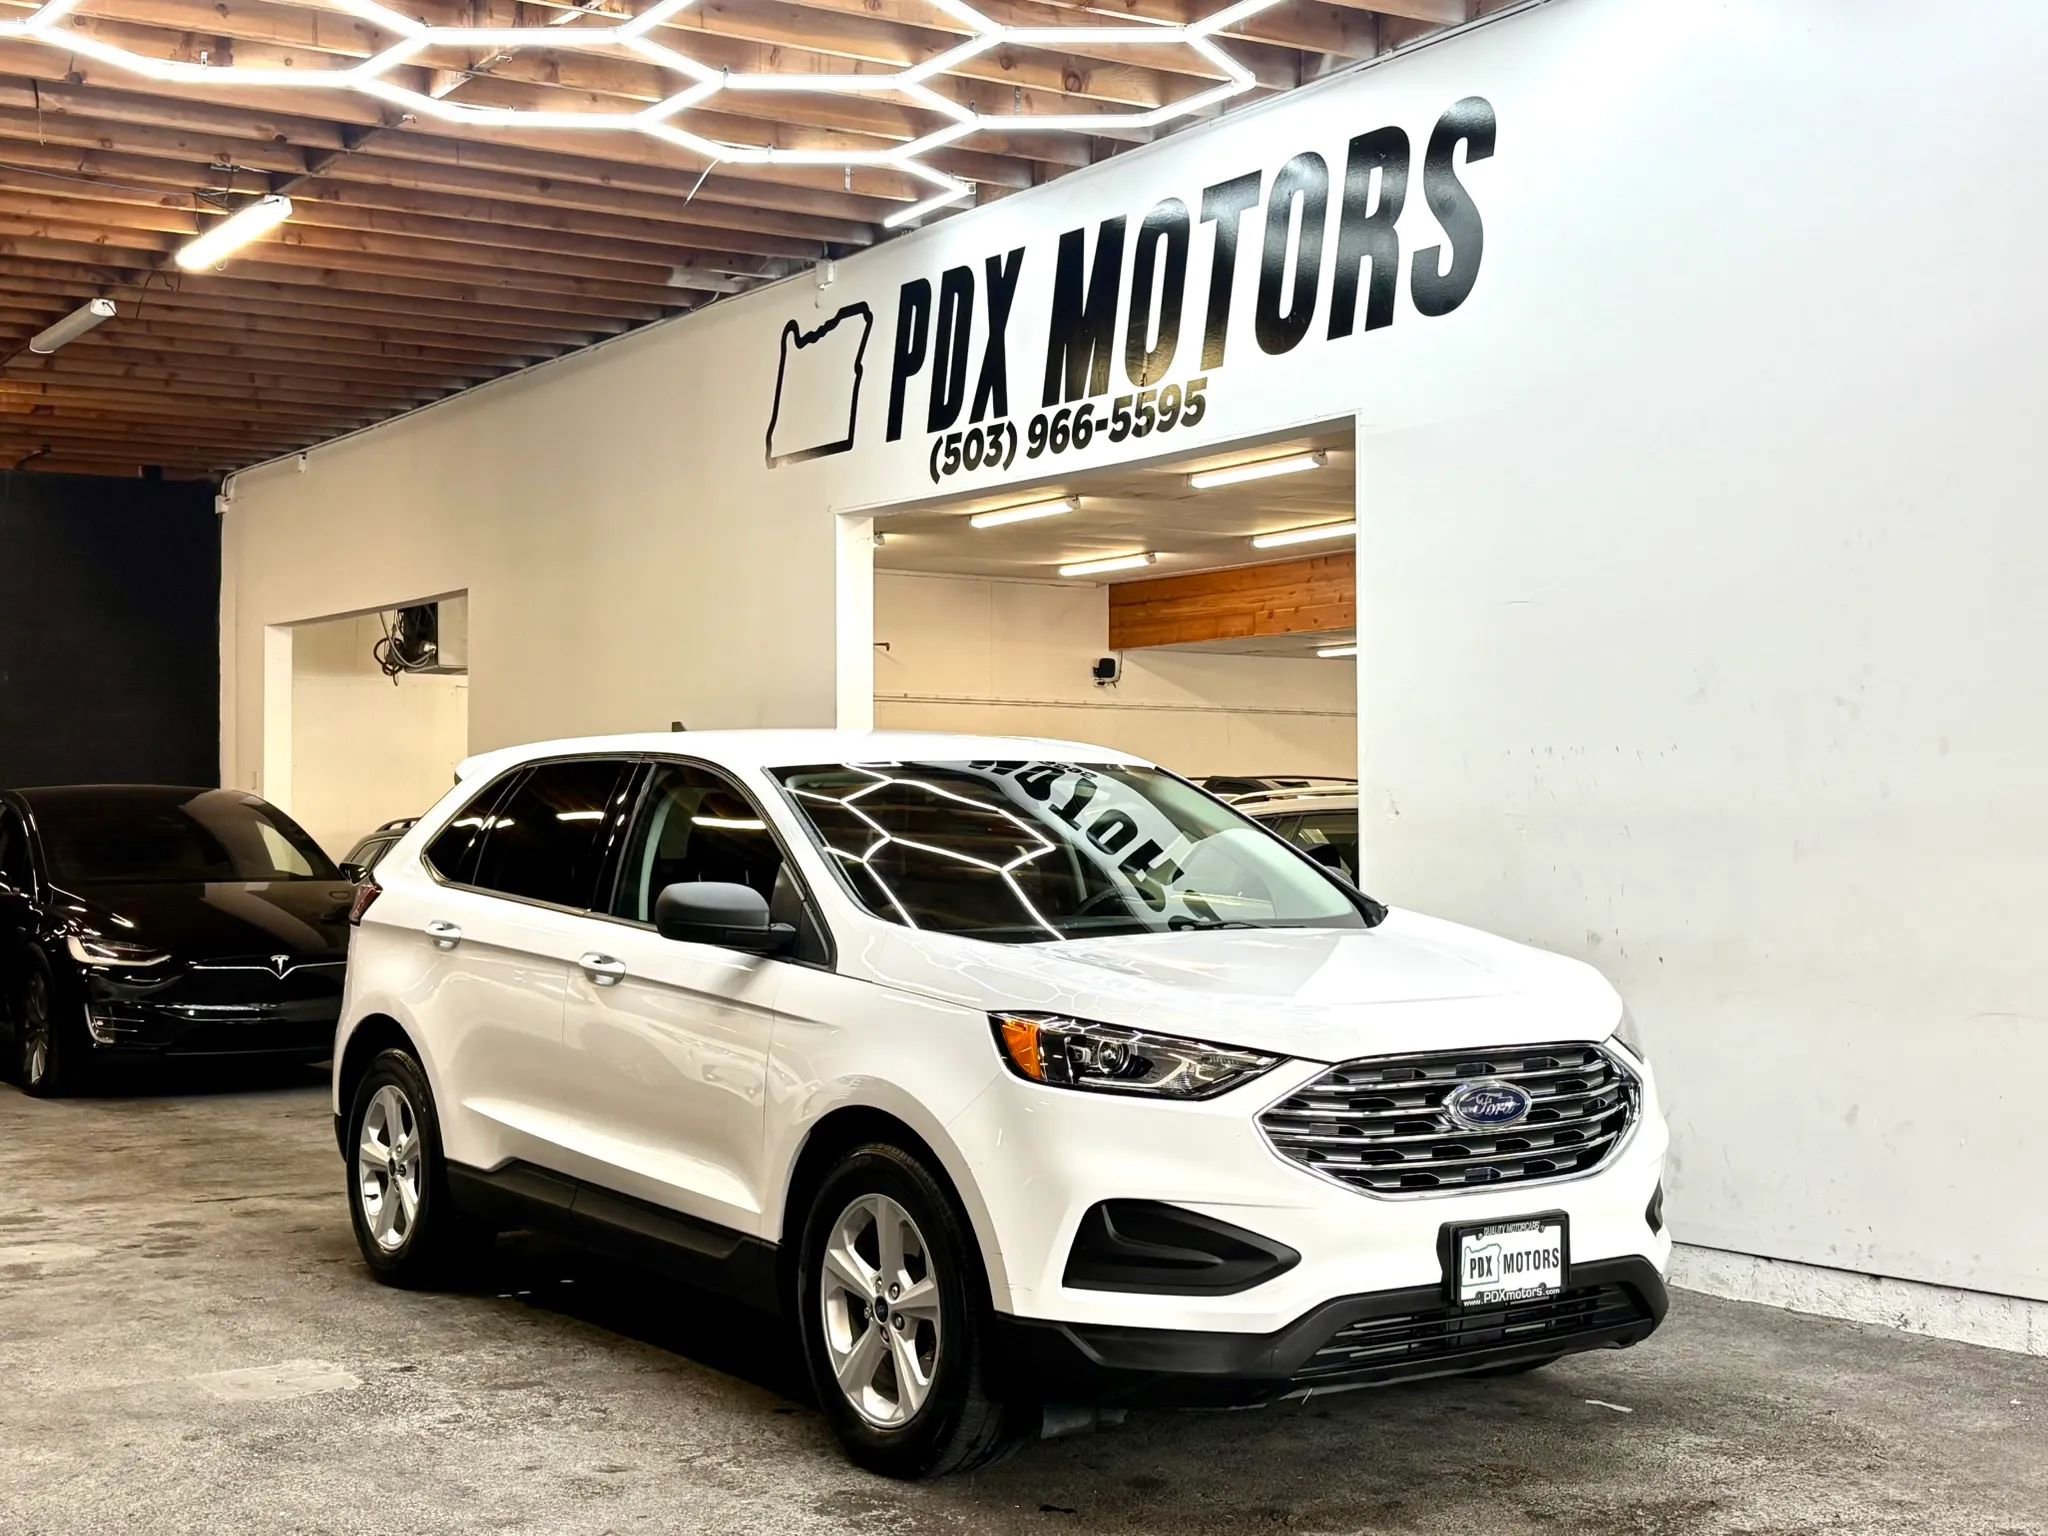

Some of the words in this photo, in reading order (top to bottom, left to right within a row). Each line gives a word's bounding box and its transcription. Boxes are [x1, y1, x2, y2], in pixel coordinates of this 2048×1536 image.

[886, 247, 1026, 442] PDX
[1042, 96, 1497, 406] MOTORS
[930, 421, 1017, 484] (503)
[1026, 377, 1208, 459] 966-5595
[1468, 1092, 1521, 1115] Ford
[1470, 1256, 1492, 1279] PDX
[1503, 1248, 1559, 1274] MOTORS
[1463, 1287, 1560, 1306] www.PDXmotors.com
